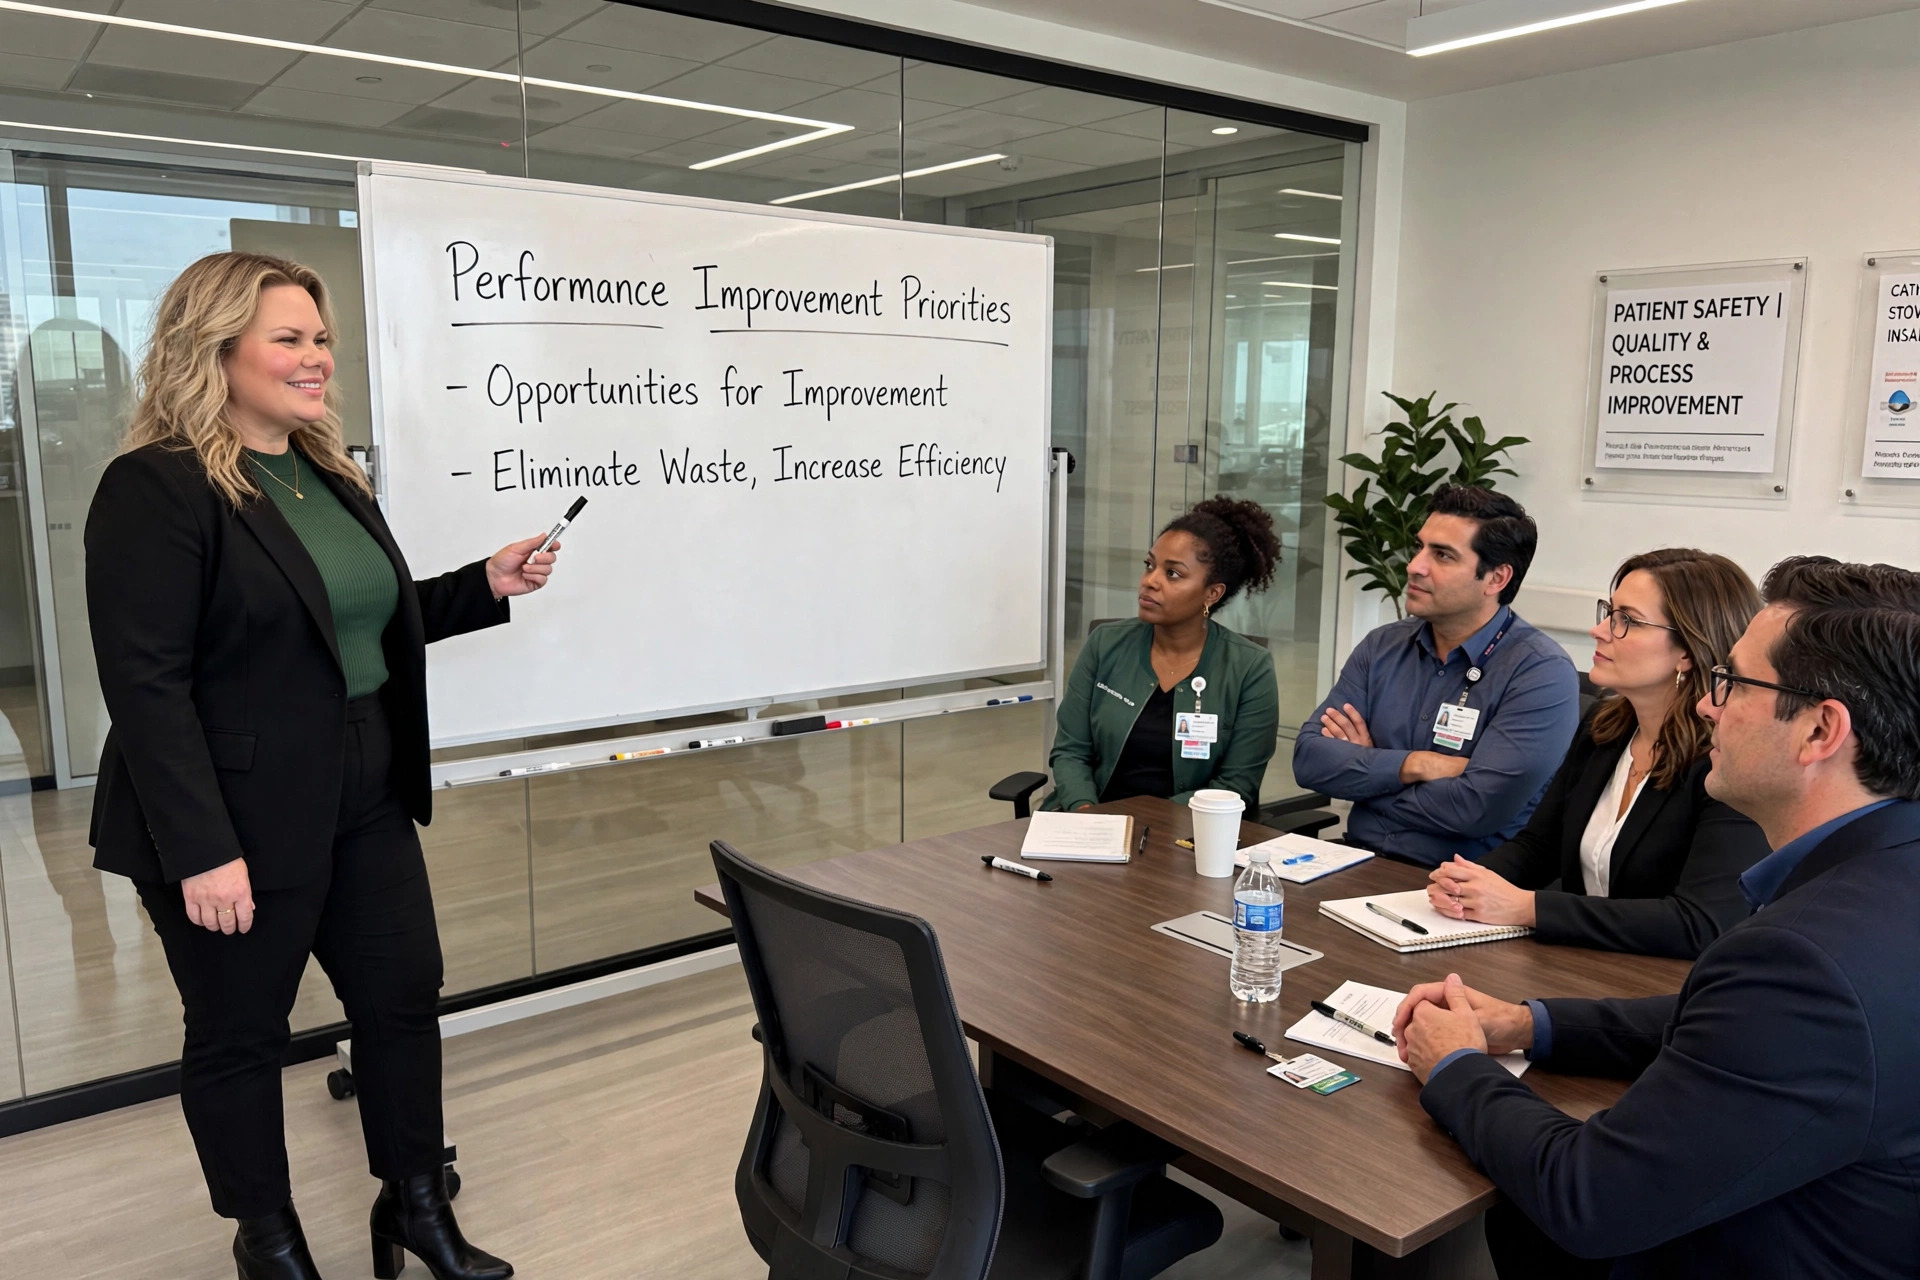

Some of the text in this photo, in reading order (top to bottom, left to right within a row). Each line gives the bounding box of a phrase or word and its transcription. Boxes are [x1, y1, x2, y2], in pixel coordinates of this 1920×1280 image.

[445, 240, 1011, 329] Performance Improvement Priorities
[1613, 299, 1689, 323] PATIENT
[1693, 295, 1770, 319] SAFETY
[1612, 331, 1710, 357] QUALITY &
[1887, 328, 1920, 343] INSA
[1609, 363, 1694, 384] PROCESS
[487, 363, 699, 424] Opportunities
[720, 364, 763, 407] for
[782, 368, 948, 422] Improvement
[1607, 395, 1744, 416] IMPROVEMENT
[493, 448, 641, 492] Eliminate
[659, 446, 757, 490] Waste,
[772, 444, 883, 482] Increase
[899, 442, 1007, 493] Efficiency
